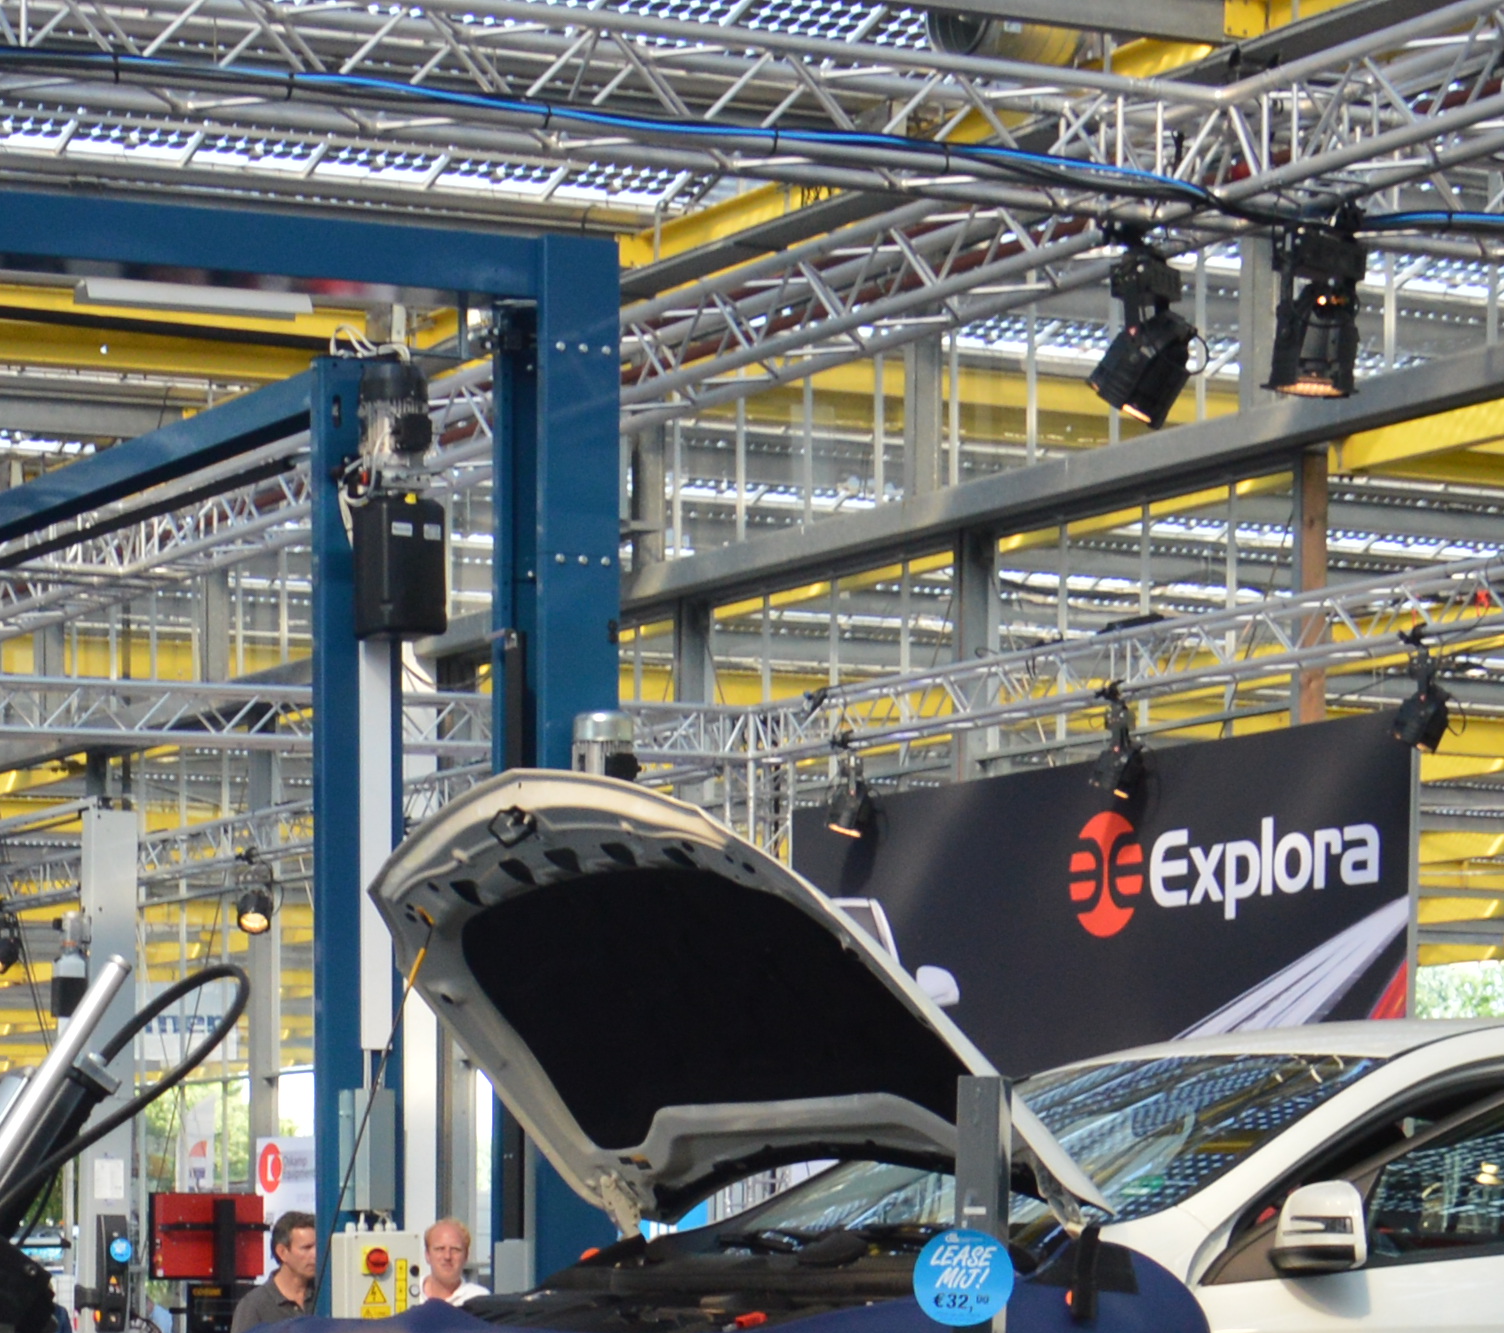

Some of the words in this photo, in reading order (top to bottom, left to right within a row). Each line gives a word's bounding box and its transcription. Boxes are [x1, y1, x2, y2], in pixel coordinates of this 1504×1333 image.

[1149, 815, 1381, 921] Explora
[929, 1244, 998, 1268] LEASE
[934, 1266, 991, 1290] MIJ!
